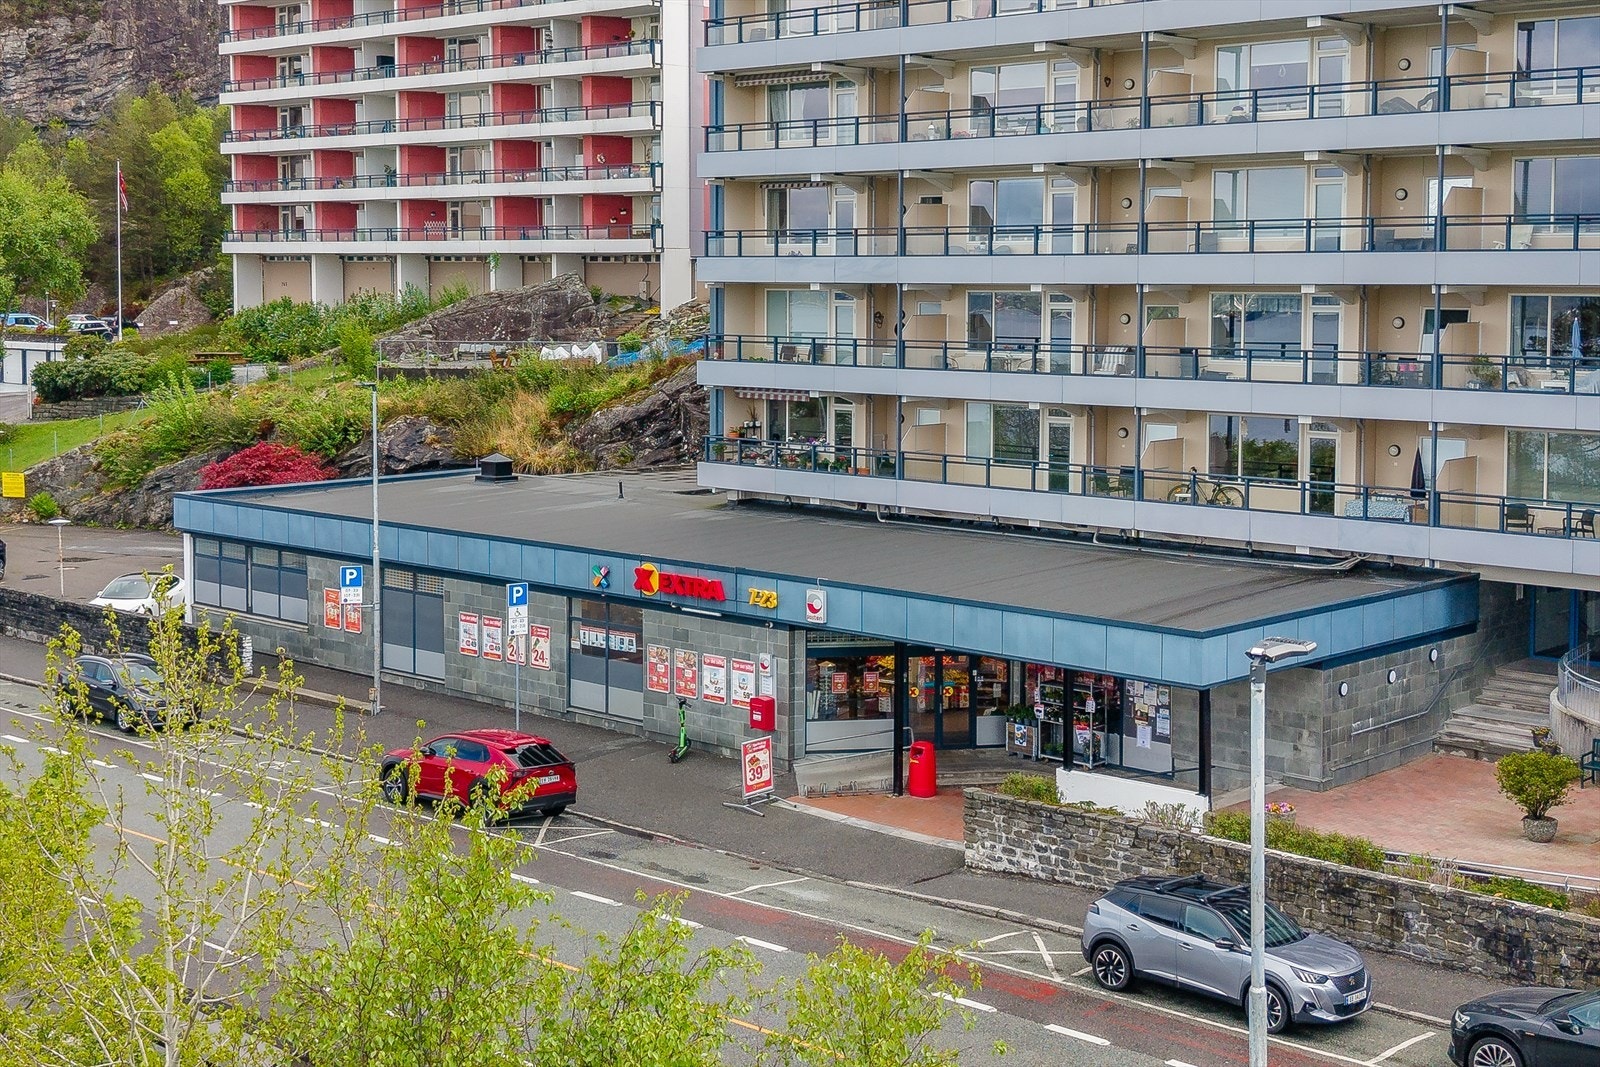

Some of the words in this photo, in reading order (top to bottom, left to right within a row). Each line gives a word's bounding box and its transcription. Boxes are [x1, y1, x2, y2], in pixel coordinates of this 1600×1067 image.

[345, 569, 357, 585] P
[513, 587, 523, 604] P
[659, 573, 725, 601] EXTRA
